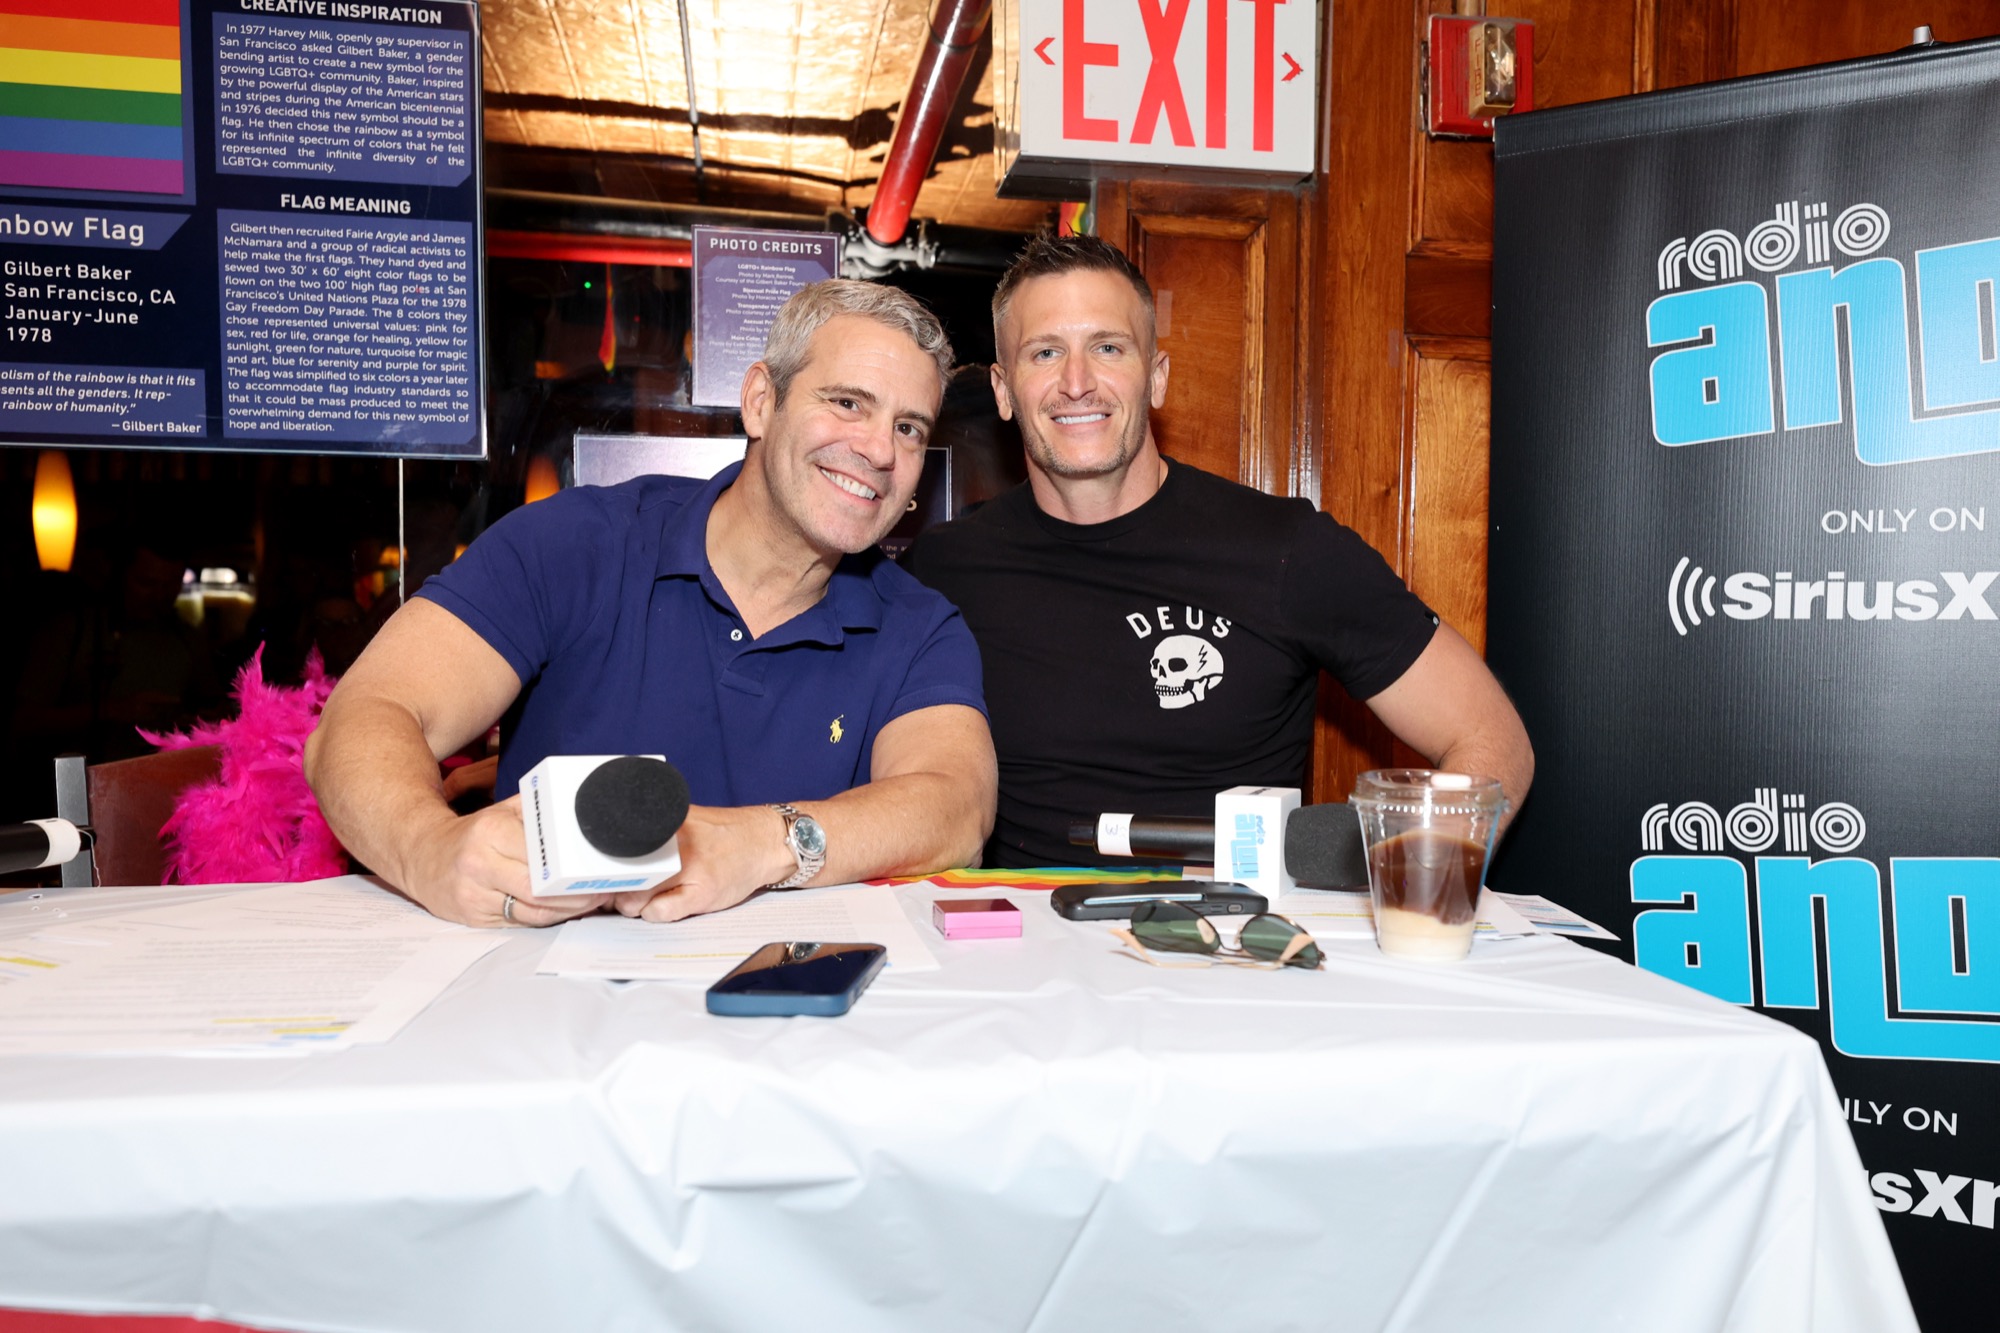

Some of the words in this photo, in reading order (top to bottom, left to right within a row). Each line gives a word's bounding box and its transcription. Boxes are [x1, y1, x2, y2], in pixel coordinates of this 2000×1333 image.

[240, 0, 327, 16] CREATIVE
[331, 3, 442, 24] INSPIRATION
[226, 24, 236, 34] In
[240, 25, 264, 36] 1977
[268, 26, 305, 41] Harvey
[309, 29, 332, 42] Milk,
[336, 31, 372, 46] openly
[375, 36, 394, 47] gay
[397, 35, 450, 51] supervisor
[453, 39, 463, 49] in
[219, 36, 239, 47] San
[245, 38, 296, 51] Francisco
[301, 42, 332, 53] asked
[337, 44, 373, 56] Gilbert
[378, 47, 409, 60] Baker,
[426, 50, 463, 64] gender
[220, 50, 264, 65] bending
[268, 53, 294, 64] artist
[298, 55, 309, 65] to
[312, 56, 346, 68] create
[360, 61, 383, 70] new
[386, 60, 424, 75] symbol
[428, 63, 443, 74] for
[446, 64, 463, 75] the
[1474, 38, 1482, 97] FIRE
[220, 63, 264, 78] growing
[269, 66, 314, 81] LGBTQ+
[319, 69, 382, 85] community.
[387, 73, 418, 86] Baker,
[422, 75, 463, 90] inspired
[220, 76, 233, 89] by
[237, 77, 255, 88] the
[259, 78, 307, 94] powerful
[310, 82, 347, 96] display
[350, 84, 362, 94] of
[365, 85, 383, 96] the
[386, 86, 436, 99] American
[439, 89, 464, 100] stars
[1062, 0, 1286, 153] EXIT
[220, 89, 240, 100] and
[246, 91, 280, 105] stripes
[285, 93, 319, 108] during
[324, 96, 341, 106] the
[346, 97, 396, 110] American
[400, 100, 464, 114] bicentennial
[221, 102, 230, 113] in
[235, 103, 260, 115] 1976
[264, 105, 307, 117] decided
[311, 108, 330, 119] this
[334, 112, 356, 120] new
[360, 111, 399, 126] symbol
[402, 114, 437, 125] should
[441, 116, 454, 126] be
[221, 116, 243, 129] flag.
[248, 117, 264, 128] He
[268, 118, 292, 130] then
[296, 120, 329, 132] chose
[333, 122, 350, 133] the
[354, 123, 397, 135] rainbow
[401, 128, 412, 136] as
[426, 127, 464, 142] symbol
[221, 129, 237, 140] for
[242, 130, 254, 141] its
[258, 131, 294, 143] infinite
[299, 133, 349, 149] spectrum
[353, 136, 364, 147] of
[368, 137, 402, 149] colors
[405, 140, 426, 150] that
[430, 141, 444, 151] he
[448, 142, 464, 152] felt
[222, 143, 286, 159] represented
[297, 147, 315, 158] the
[326, 149, 362, 160] infinite
[372, 151, 415, 166] diversity
[426, 154, 437, 165] of
[447, 156, 464, 166] the
[222, 155, 268, 170] LGBTQ+
[272, 158, 335, 174] community.
[281, 194, 325, 210] FLAG
[330, 196, 411, 214] MEANING
[84, 217, 144, 246] Flag
[230, 223, 266, 234] Gilbert
[269, 225, 293, 235] then
[296, 226, 343, 238] recruited
[346, 228, 373, 239] Fairie
[375, 230, 408, 244] Argyle
[410, 231, 429, 242] and
[431, 232, 465, 244] James
[710, 238, 757, 251] PHOTO
[762, 240, 822, 255] CREDITS
[1657, 200, 1891, 290] radio
[4, 260, 71, 278] Gilbert
[77, 264, 132, 280] Baker
[5, 283, 40, 298] San
[46, 284, 143, 305] Francisco,
[150, 289, 176, 304] CA
[7, 326, 52, 342] 1978
[37, 370, 50, 381] of
[52, 371, 73, 382] the
[75, 372, 124, 384] rainbow
[126, 373, 137, 384] is
[139, 374, 163, 385] that
[165, 374, 174, 385] it
[176, 375, 196, 386] fits
[2, 400, 52, 411] rainbow
[55, 400, 69, 411] of
[37, 386, 53, 396] all
[55, 386, 75, 397] the
[77, 387, 131, 399] genders.
[134, 389, 143, 399] It
[145, 390, 172, 402] rep-
[122, 421, 164, 433] Gilbert
[166, 422, 201, 434] Baker
[1821, 508, 1917, 534] ONLY
[1928, 506, 1985, 532] ON
[1722, 571, 2000, 620] SiriusX
[1125, 606, 1232, 639] DEUS
[1641, 788, 1867, 853] radio
[1902, 1106, 1958, 1136] ON
